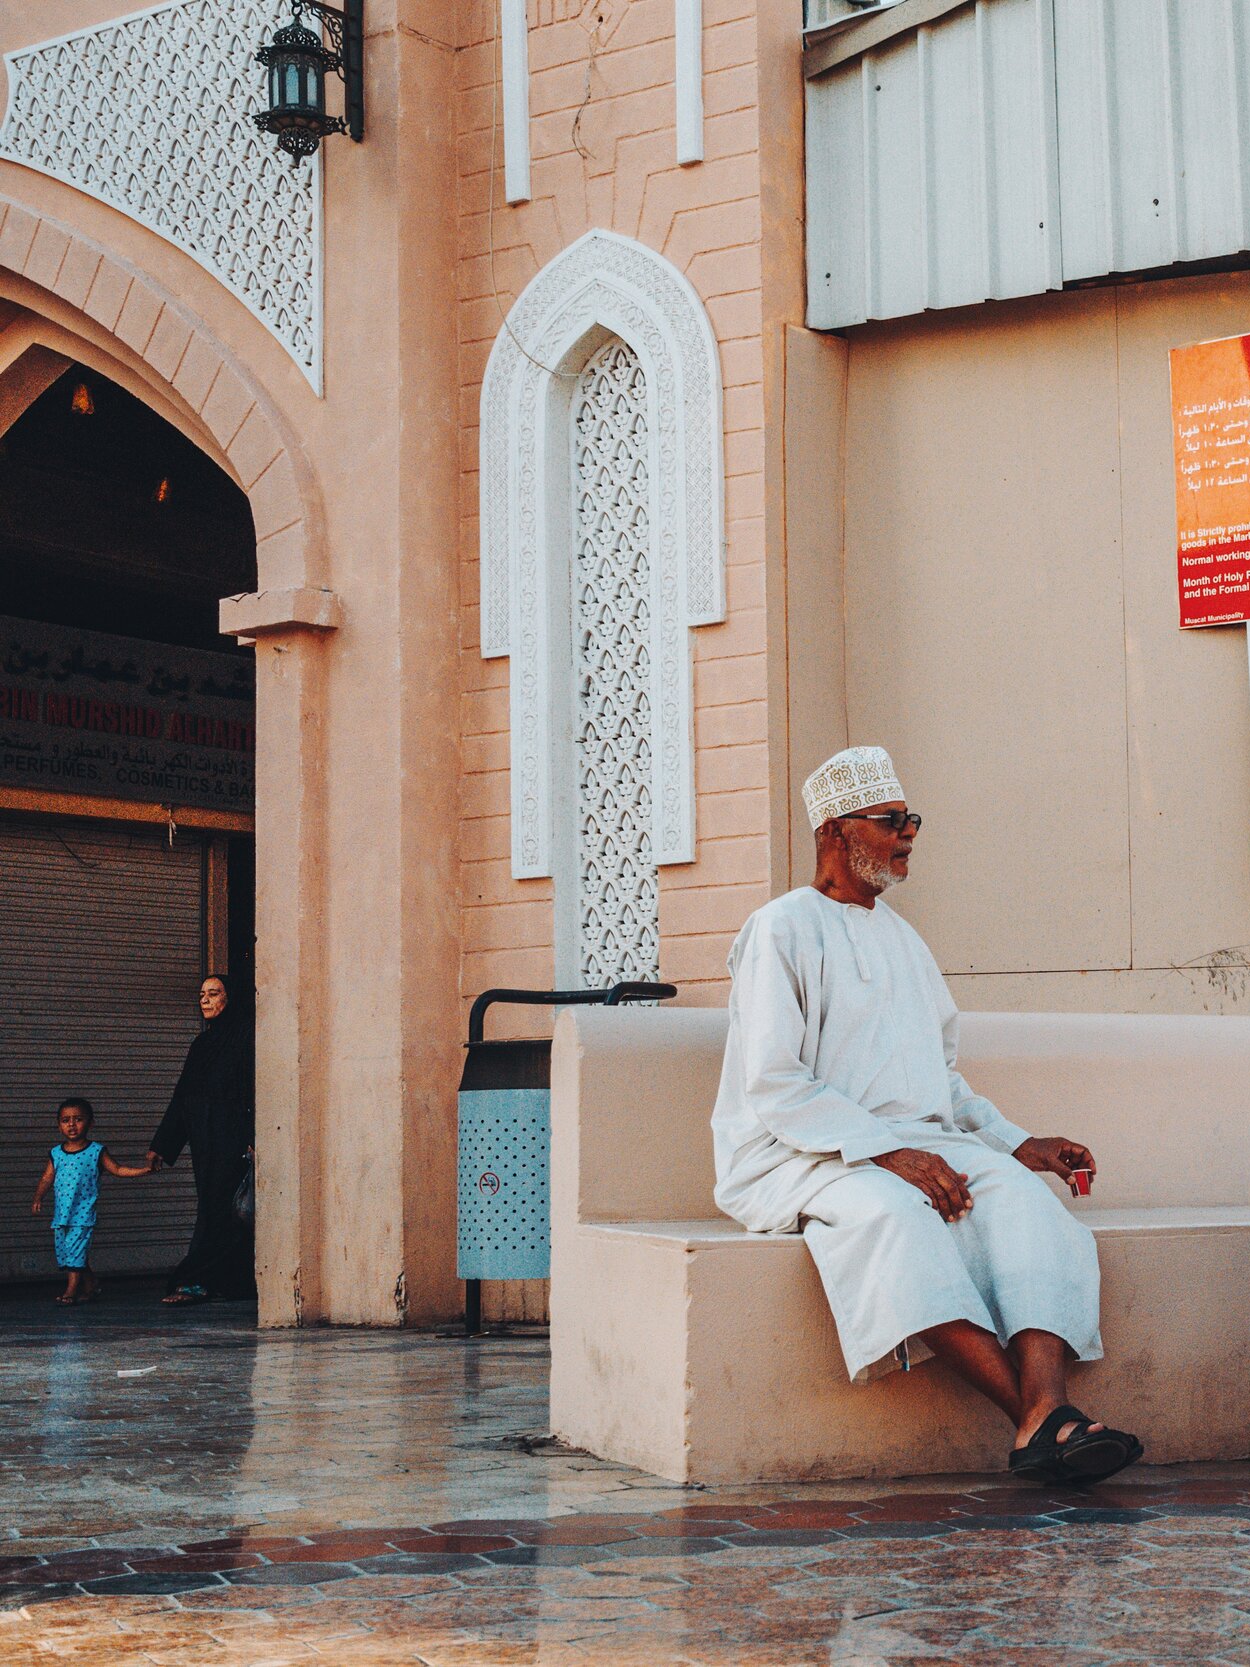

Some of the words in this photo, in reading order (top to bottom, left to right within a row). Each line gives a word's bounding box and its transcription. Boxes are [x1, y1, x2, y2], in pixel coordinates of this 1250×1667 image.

[1181, 532, 1186, 540] It
[1188, 531, 1195, 539] is
[1197, 526, 1225, 538] Strictly
[1181, 539, 1206, 551] goods
[1208, 537, 1216, 546] in
[1218, 535, 1231, 544] the
[1182, 555, 1214, 567] Normal
[1216, 550, 1250, 562] working
[1183, 576, 1211, 588] Month
[1213, 574, 1222, 583] of
[1224, 571, 1243, 583] Holy
[1184, 588, 1200, 599] and
[1203, 586, 1217, 596] the
[1219, 582, 1250, 595] Formal
[1185, 616, 1206, 624] Muscat
[1208, 612, 1244, 622] Municipality
[46, 692, 161, 739] MURSHID
[116, 767, 210, 793] COSMETICS
[214, 780, 224, 795] &
[229, 781, 254, 798] BA
